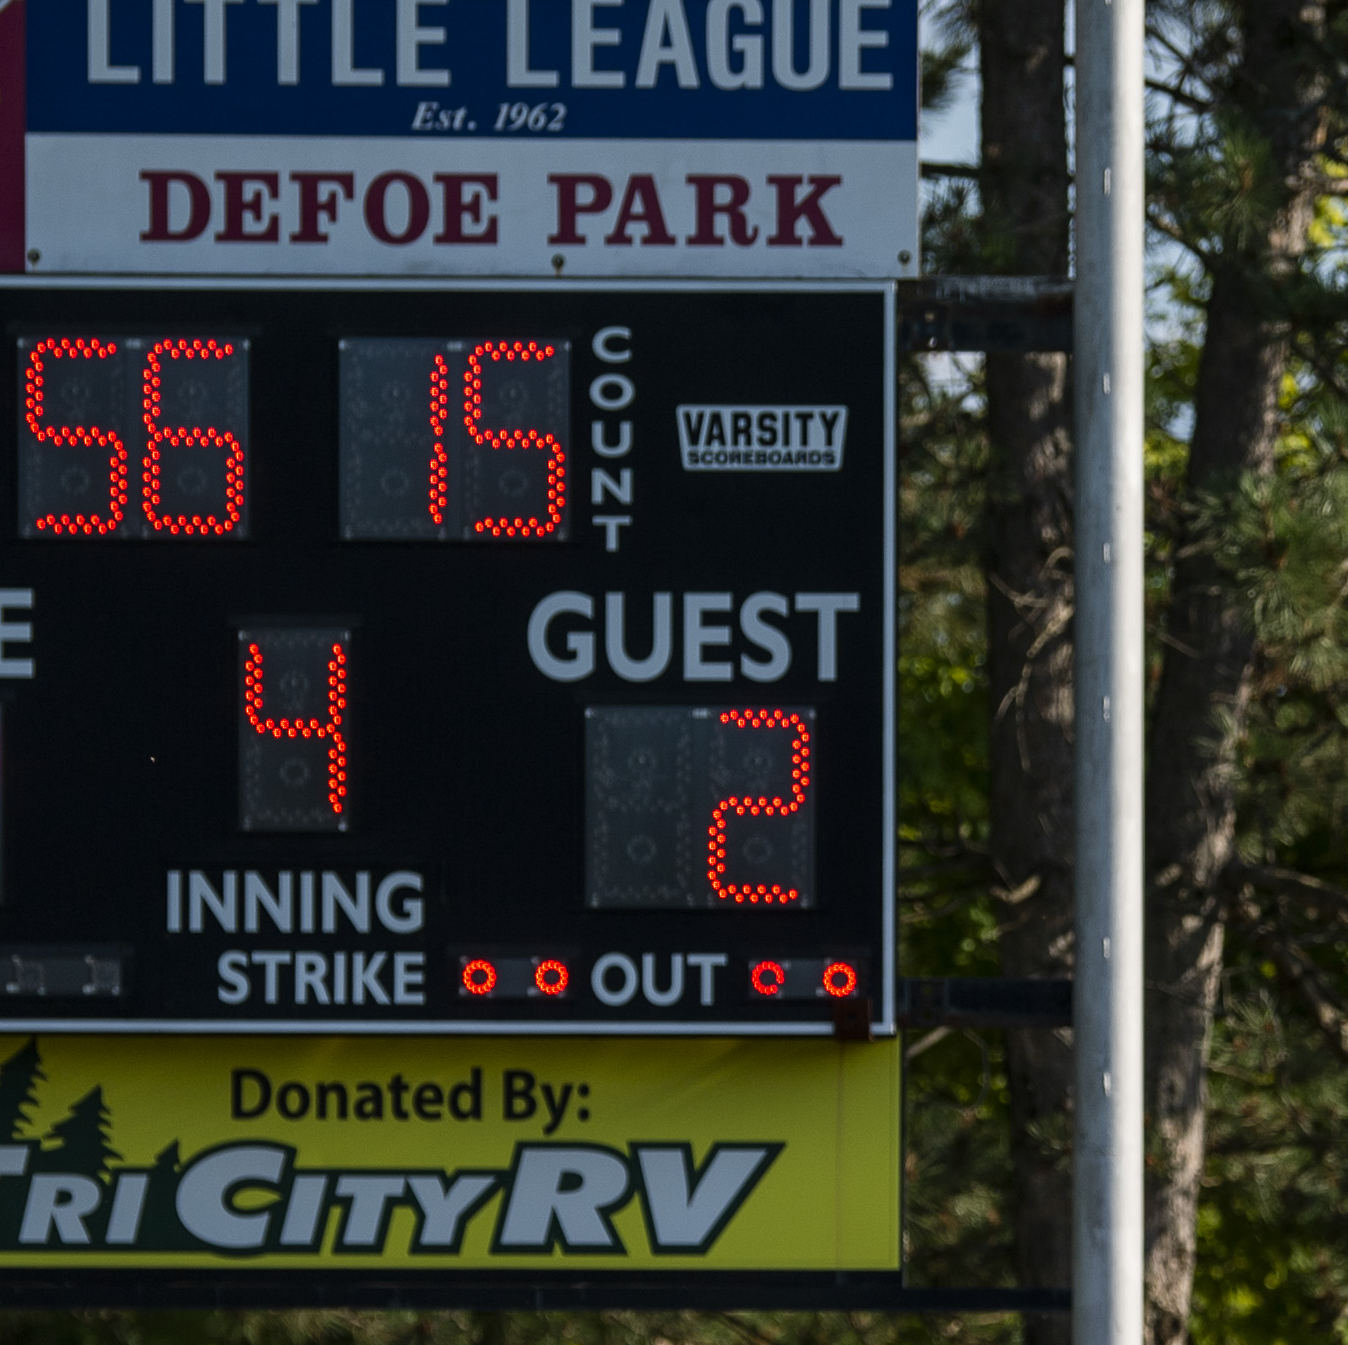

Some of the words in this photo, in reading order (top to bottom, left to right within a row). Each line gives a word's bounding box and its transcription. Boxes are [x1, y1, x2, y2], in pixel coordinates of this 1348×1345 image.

[88, 0, 450, 87] LITTLE
[506, 0, 893, 90] LEAGUE
[410, 102, 477, 131] Est.
[494, 103, 567, 132] 1962
[139, 170, 499, 246] DEFOE
[547, 173, 843, 248] PARK
[26, 338, 244, 535] 56
[429, 340, 566, 538] 15
[589, 325, 635, 552] COUNT
[683, 410, 839, 447] VARSITY
[687, 450, 836, 465] SCOREBOARDS
[526, 590, 861, 683] GUEST
[245, 643, 347, 814] 4
[707, 708, 810, 904] 2
[166, 869, 425, 934] INNING
[217, 951, 425, 1005] STRIKE
[591, 953, 728, 1006] OUT
[230, 1066, 484, 1121] Donated
[502, 1067, 591, 1135] By:
[498, 1146, 770, 1247] RV
